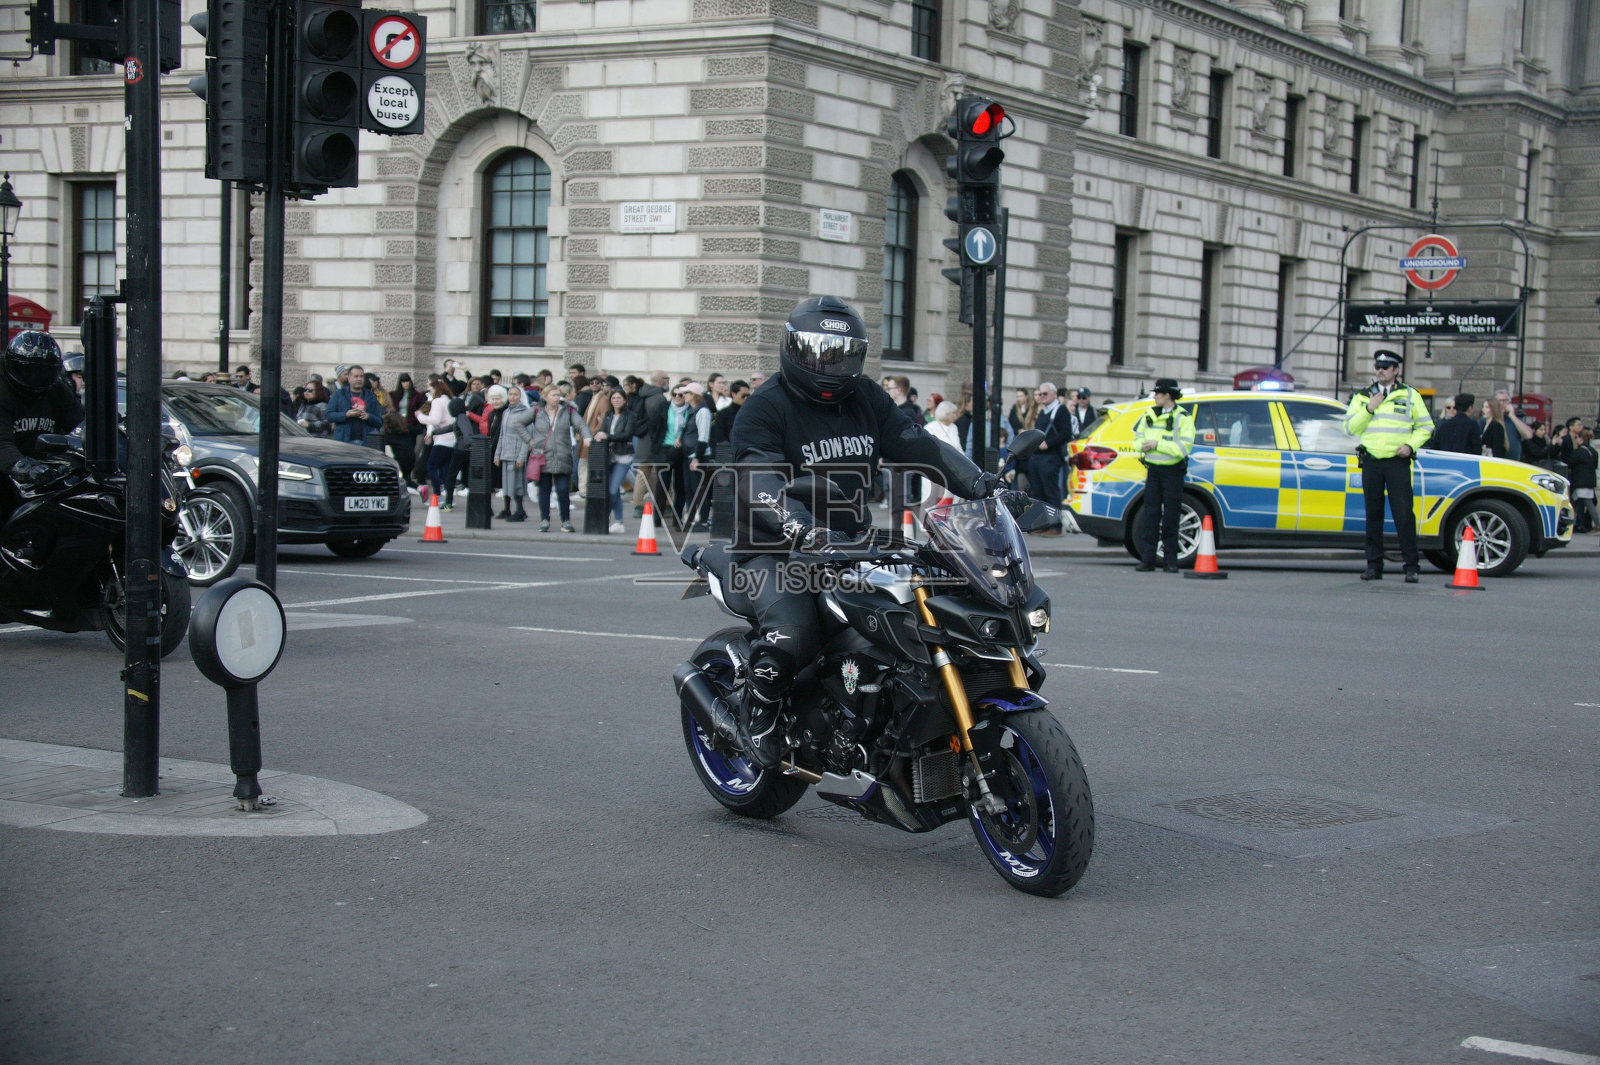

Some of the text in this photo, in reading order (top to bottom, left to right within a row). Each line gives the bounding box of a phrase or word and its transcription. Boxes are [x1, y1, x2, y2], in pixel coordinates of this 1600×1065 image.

[374, 83, 414, 97] Except
[379, 97, 408, 108] local
[376, 109, 410, 121] buses
[623, 204, 672, 214] GREAT GEORGE
[623, 214, 648, 223] STREET
[1404, 259, 1460, 267] UNDERGROUND
[824, 320, 847, 331] SHOEI
[1364, 314, 1496, 326] Westminster Station
[1360, 325, 1486, 334] Public Subway Toilets
[801, 434, 874, 466] SLOW BOYS
[348, 499, 369, 509] LM20
